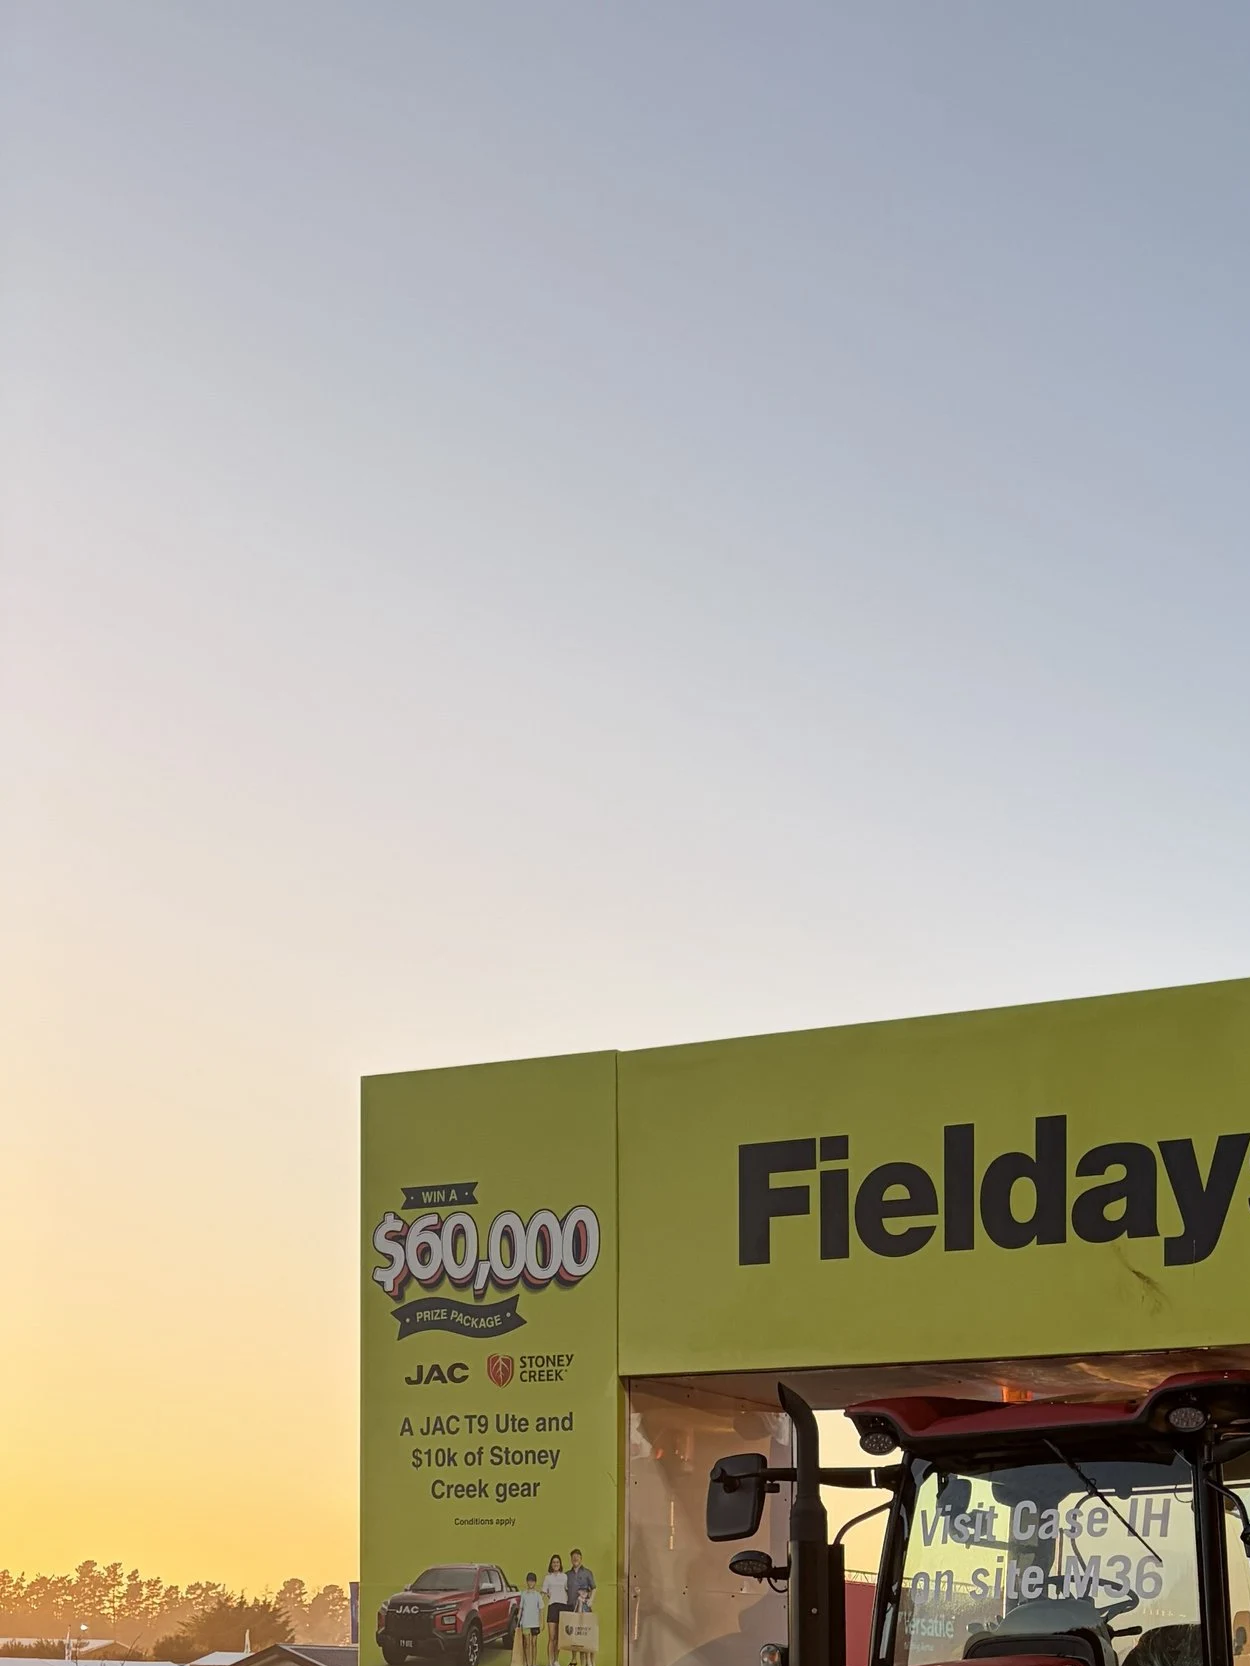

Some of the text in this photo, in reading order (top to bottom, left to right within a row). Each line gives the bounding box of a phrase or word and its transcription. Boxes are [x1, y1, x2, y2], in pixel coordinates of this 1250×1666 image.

[421, 1189, 458, 1205] WIN A
[372, 1205, 601, 1296] $60,000
[416, 1307, 503, 1329] PRIZE PACKAGE
[404, 1362, 470, 1385] JAC
[519, 1353, 575, 1370] STONEY
[400, 1411, 574, 1437] A JAC T9 Ute and
[411, 1446, 561, 1471] $10k of Stoney
[430, 1478, 541, 1503] Creek gear
[454, 1517, 516, 1527] Conditions apply
[919, 1497, 1173, 1548] Visit Case IH
[911, 1555, 1163, 1605] on site M36
